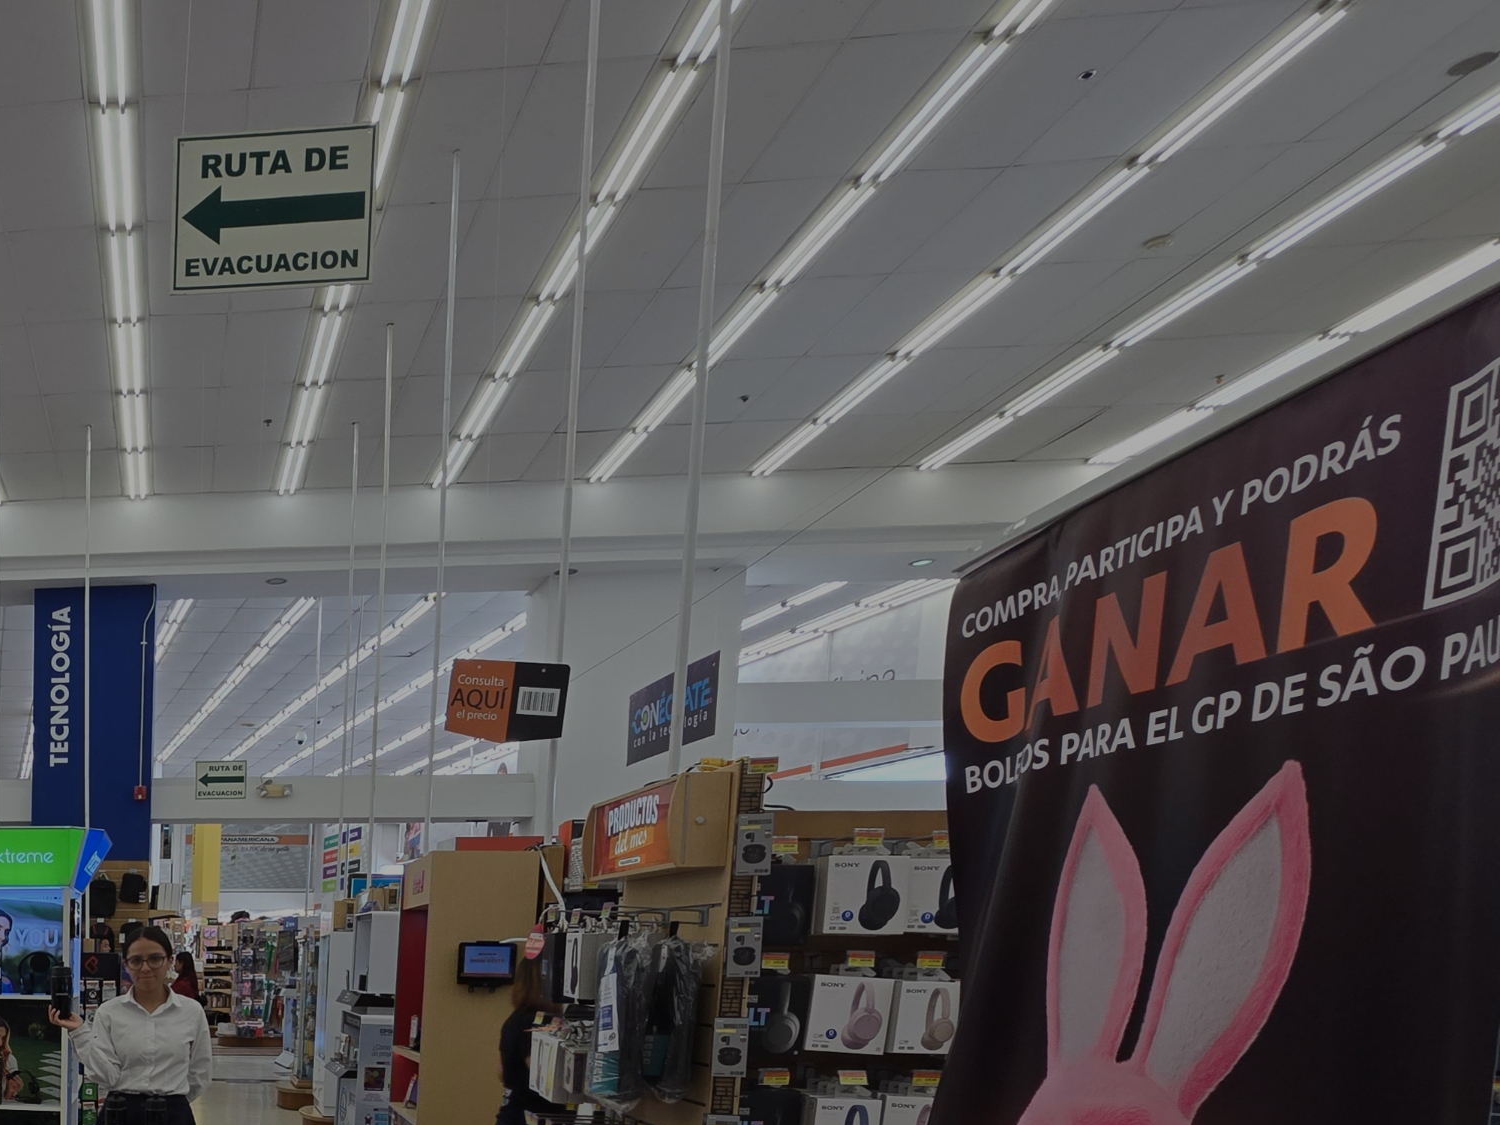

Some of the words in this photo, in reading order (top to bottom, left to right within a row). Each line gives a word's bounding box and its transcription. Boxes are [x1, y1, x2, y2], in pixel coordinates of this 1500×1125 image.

[201, 149, 293, 179] RUTA
[304, 145, 350, 172] DE
[184, 248, 359, 277] EVACUACION
[1065, 506, 1204, 591] PARTICIPA
[1211, 489, 1235, 527] Y
[1240, 413, 1402, 515] PODRÁS
[959, 496, 1378, 743] GANAR
[47, 606, 71, 767] TECNOLOGÍA
[456, 674, 505, 687] Consulta
[1059, 718, 1137, 765] PARA
[1145, 709, 1184, 747] EL
[1191, 690, 1242, 735] GP
[1250, 673, 1307, 723] DE
[1316, 643, 1426, 708] SÃO
[1440, 614, 1500, 681] PAU
[450, 687, 508, 710] AQUÍ
[456, 710, 465, 720] el
[466, 711, 498, 722] precio
[607, 793, 660, 837] PRODUCTOS
[14, 928, 60, 948] YOU
